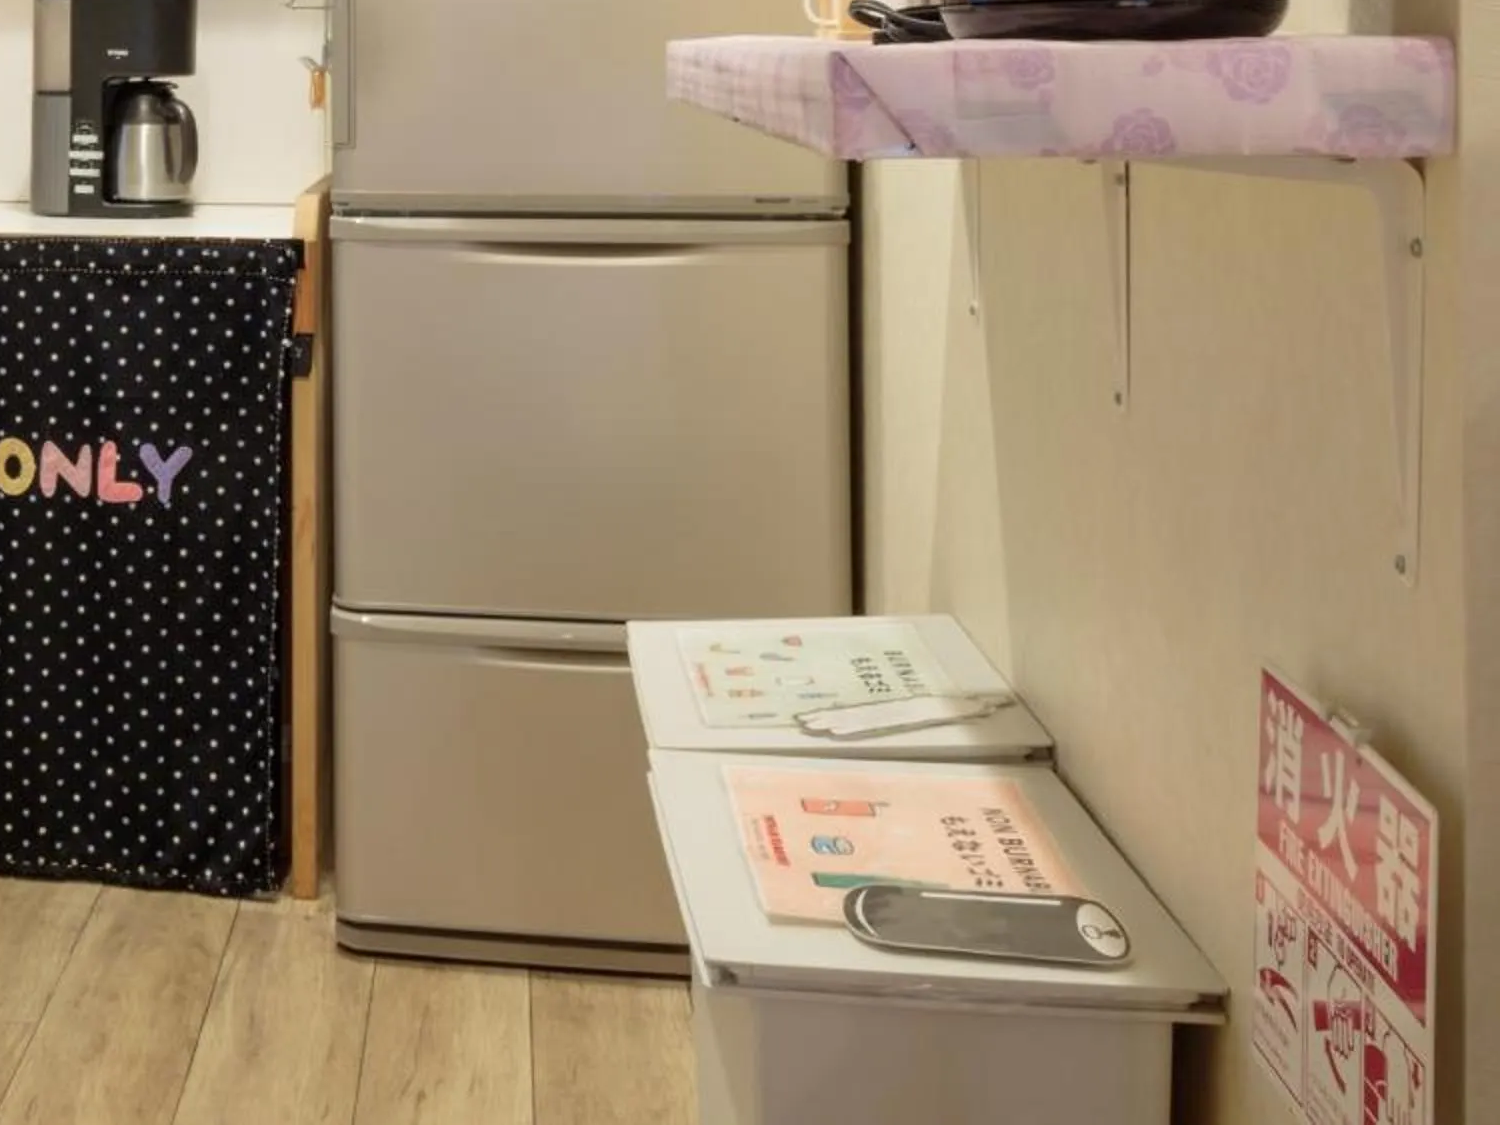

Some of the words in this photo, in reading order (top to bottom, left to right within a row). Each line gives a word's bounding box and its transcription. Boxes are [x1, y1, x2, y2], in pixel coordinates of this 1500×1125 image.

[1263, 689, 1420, 953] 消火器
[1279, 820, 1304, 876] FIRE
[1307, 849, 1398, 983] EXTINGUISHER
